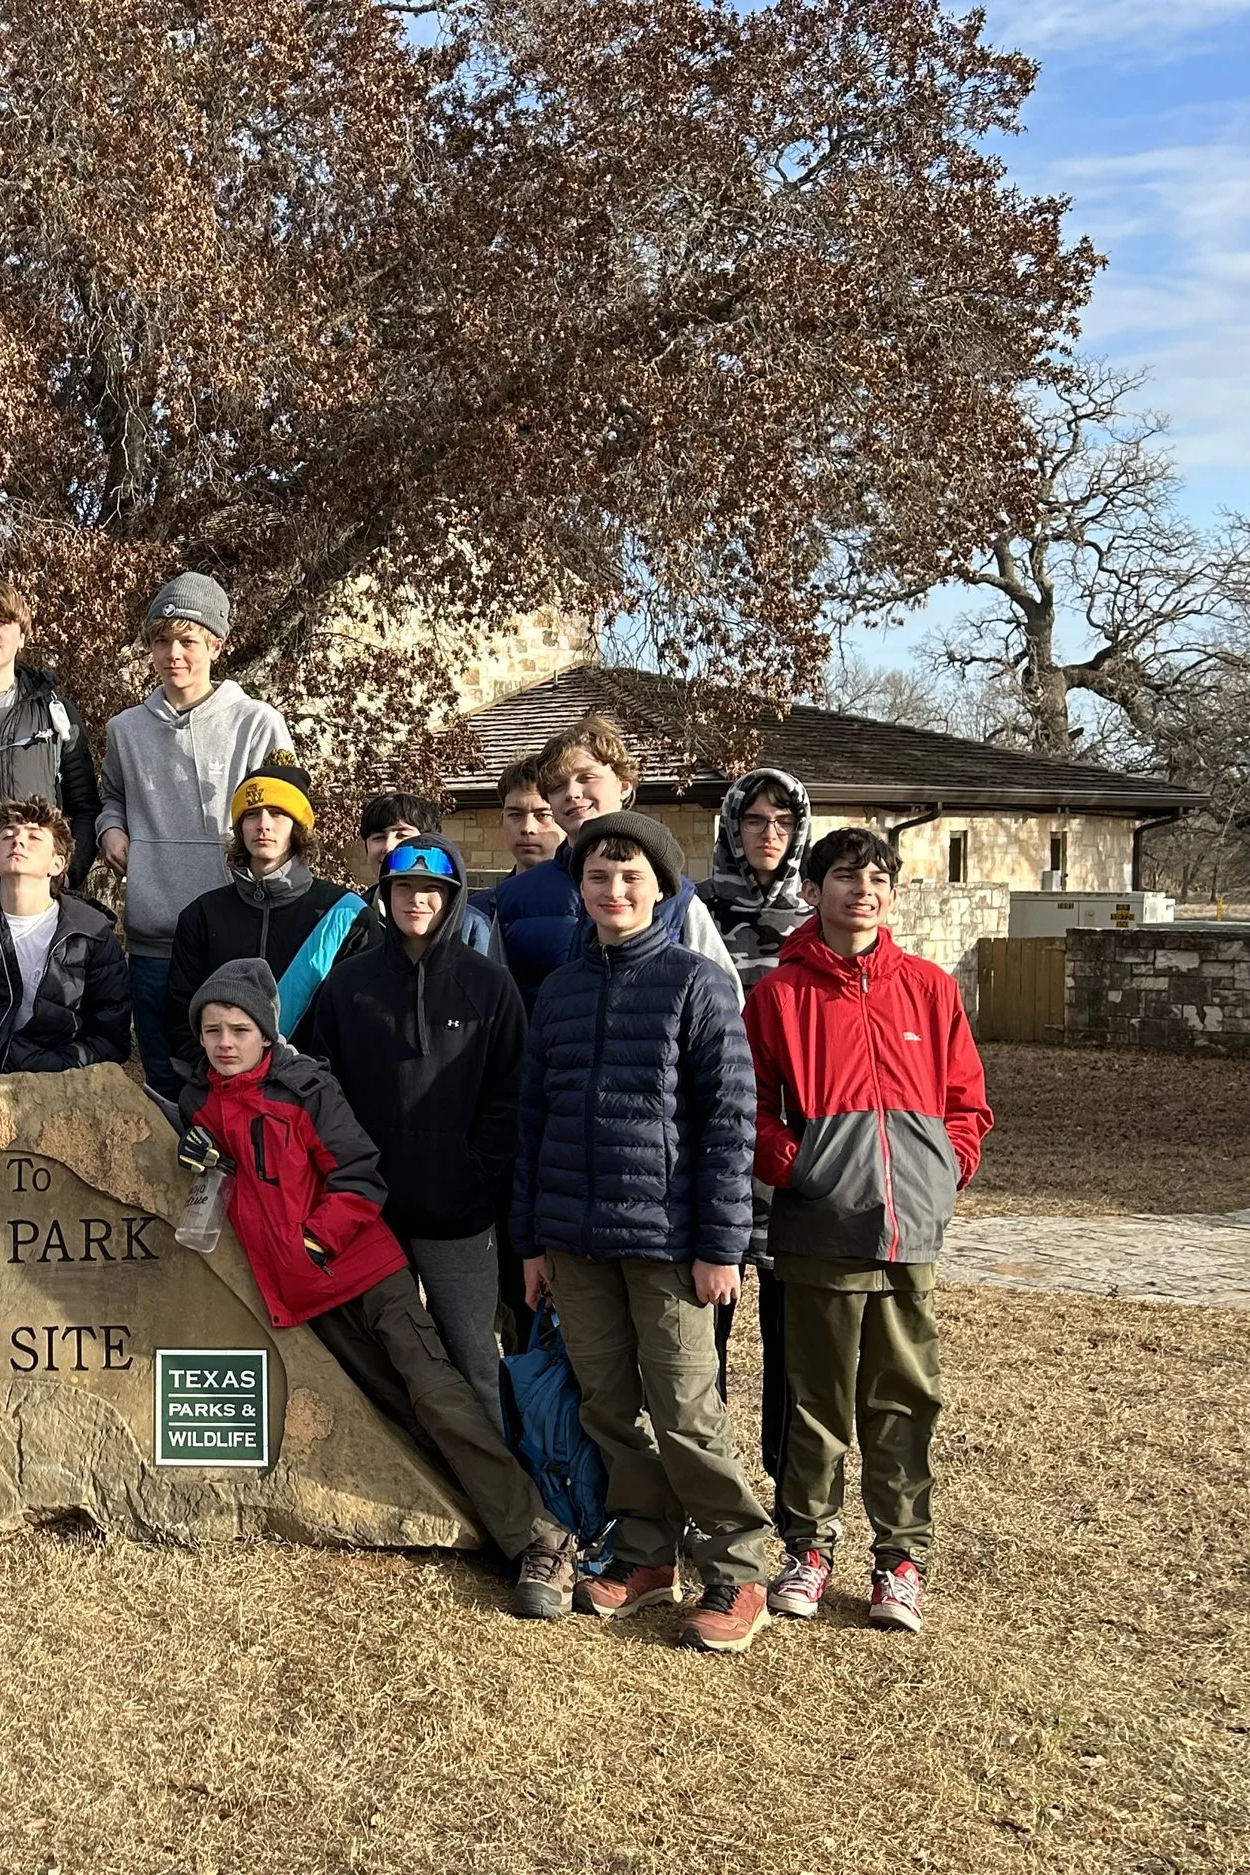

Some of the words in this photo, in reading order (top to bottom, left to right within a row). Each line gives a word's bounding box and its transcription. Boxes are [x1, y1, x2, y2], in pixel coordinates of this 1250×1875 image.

[7, 1158, 52, 1194] To
[7, 1217, 160, 1264] PARK
[9, 1325, 134, 1373] SITE
[169, 1368, 256, 1390] TEXAS
[168, 1402, 236, 1418] PARKS
[240, 1402, 257, 1418] &
[168, 1430, 257, 1449] WILDLIFE
